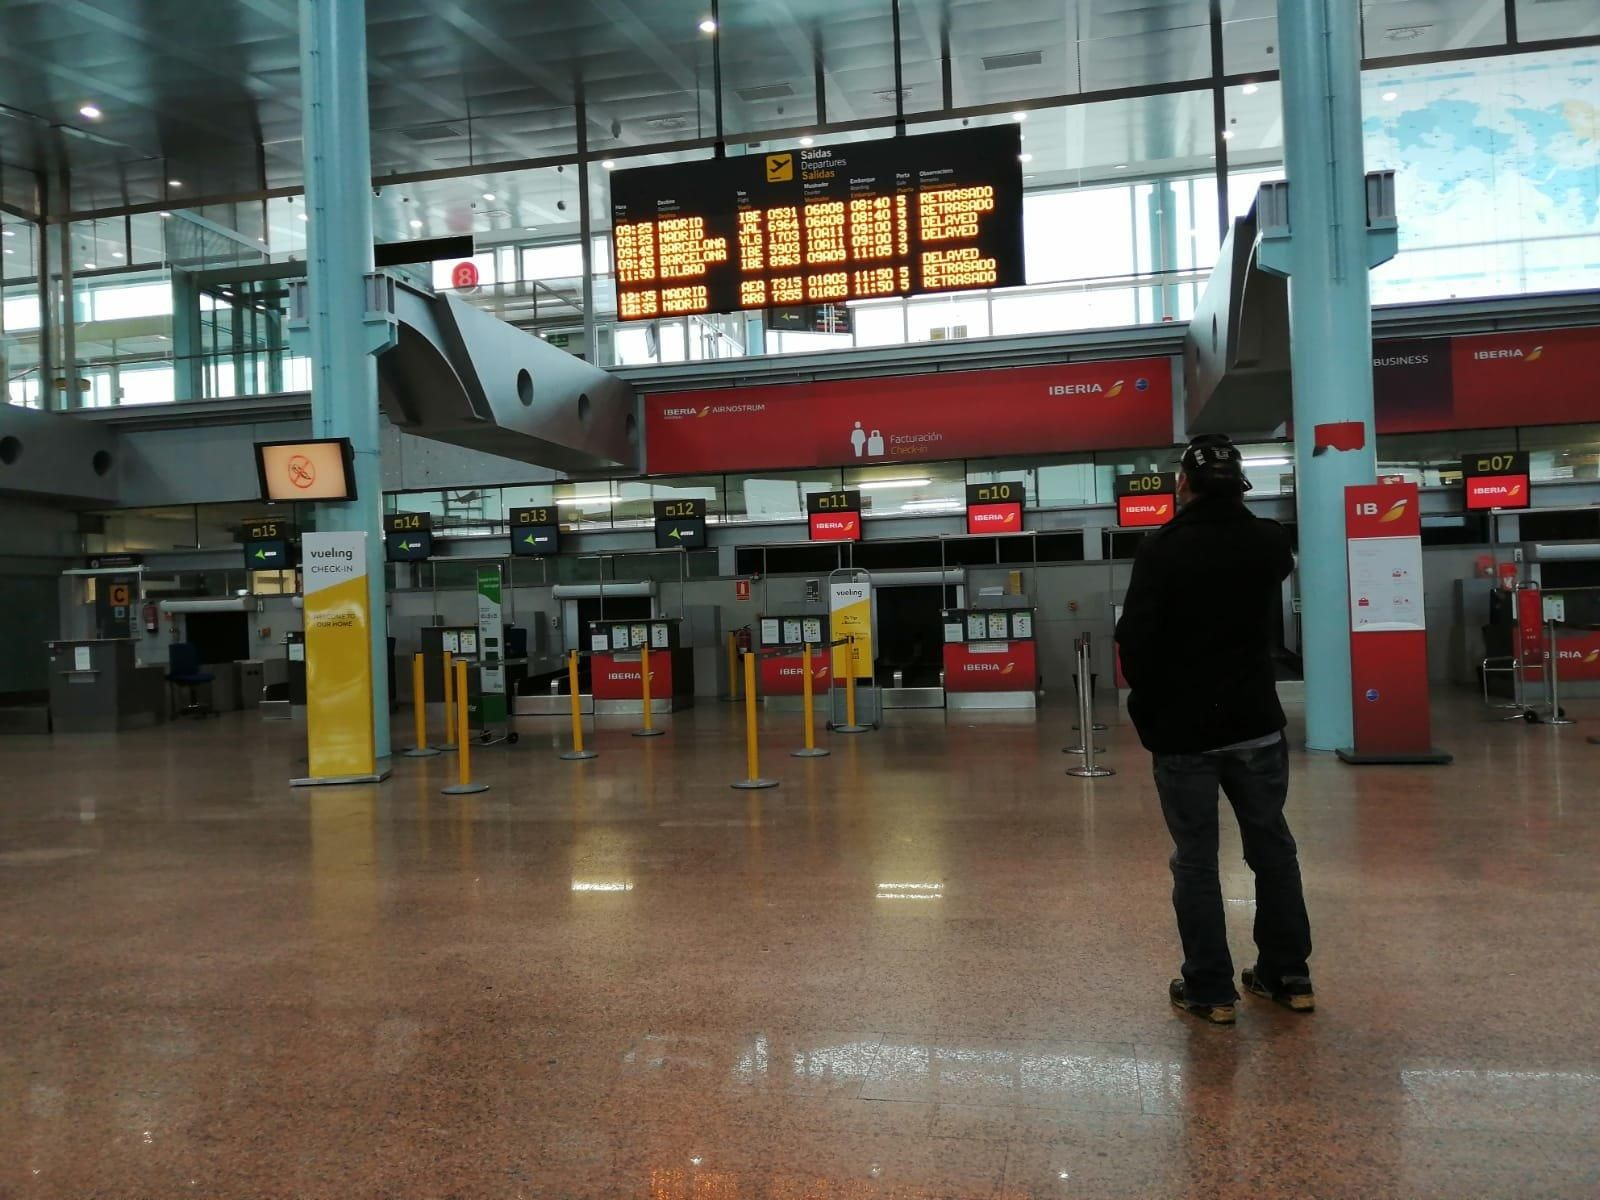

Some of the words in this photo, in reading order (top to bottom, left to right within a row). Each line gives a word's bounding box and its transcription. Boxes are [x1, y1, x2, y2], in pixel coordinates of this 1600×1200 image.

[801, 159, 847, 170] Departures
[802, 170, 835, 180] Salidas
[615, 222, 653, 236] 09:25
[658, 216, 703, 232] MADRID
[739, 211, 761, 223] IBE
[767, 207, 797, 220] 0531
[805, 202, 844, 216] 06A08
[850, 196, 890, 211] 08:40
[896, 194, 906, 207] 5
[920, 186, 993, 204] RETRASADO
[616, 234, 653, 247] 09:25
[659, 228, 704, 243] MADRID
[739, 223, 762, 235] JAL
[805, 214, 845, 228] 06A08
[851, 208, 891, 223] 08:40
[897, 207, 907, 219] 5
[920, 198, 994, 217] RETRASADO
[617, 245, 654, 258] 09:45
[659, 238, 726, 255] BARCELONA
[769, 230, 799, 243] 1703
[807, 226, 844, 240] 10A11
[851, 221, 891, 235] 09:00
[897, 219, 907, 230] 3
[921, 212, 978, 228] DELAYED
[618, 256, 655, 270] 09:45
[660, 250, 727, 266] BARCELONA
[741, 246, 763, 258] IBE
[769, 242, 800, 255] 5903
[808, 238, 845, 251] 10A11
[852, 232, 892, 247] 09:00
[898, 231, 907, 242] 3
[921, 224, 978, 240] DELAYED
[619, 268, 655, 282] 11:50
[661, 263, 705, 278] BILBAO
[742, 257, 764, 270] IBE
[807, 249, 846, 263] 09A09
[853, 245, 892, 259] 11:05
[898, 243, 908, 254] 3
[922, 248, 979, 264] DELAYED
[621, 290, 657, 304] 12:35
[662, 286, 707, 300] MADRID
[741, 280, 765, 293] AEA
[771, 276, 802, 290] 7315
[808, 272, 848, 287] 01A03
[854, 268, 894, 282] 11:50
[899, 266, 909, 278] 5
[923, 258, 996, 276] RETRASADO
[621, 302, 657, 316] 12:35
[662, 298, 707, 312] MADRID
[771, 289, 803, 302] 7355
[808, 285, 848, 299] 01A03
[855, 280, 894, 295] 11:50
[900, 278, 910, 290] 5
[924, 271, 997, 288] RETRASADO
[1373, 354, 1429, 367] BUSINESS
[1474, 348, 1523, 360] IBERIA
[1048, 383, 1103, 396] IBERIA
[663, 407, 697, 416] IBERIA
[890, 432, 943, 443] Facturación
[1491, 455, 1514, 471] 07
[1141, 476, 1162, 490] 09
[991, 485, 1010, 499] 10
[1473, 486, 1508, 495] IBERIA
[831, 494, 849, 508] 11
[531, 509, 547, 522] 13
[677, 502, 694, 516] 12
[1126, 505, 1156, 513] IBERIA
[1356, 503, 1378, 515] IB
[403, 515, 420, 528] 14
[261, 524, 277, 537] 15
[310, 547, 353, 561] vueling
[311, 565, 353, 573] CHECK-IN
[114, 587, 125, 602] C
[836, 588, 863, 597] vueling
[332, 620, 353, 628] HOME
[963, 663, 999, 671] IBERIA
[608, 672, 641, 680] IBERIA
